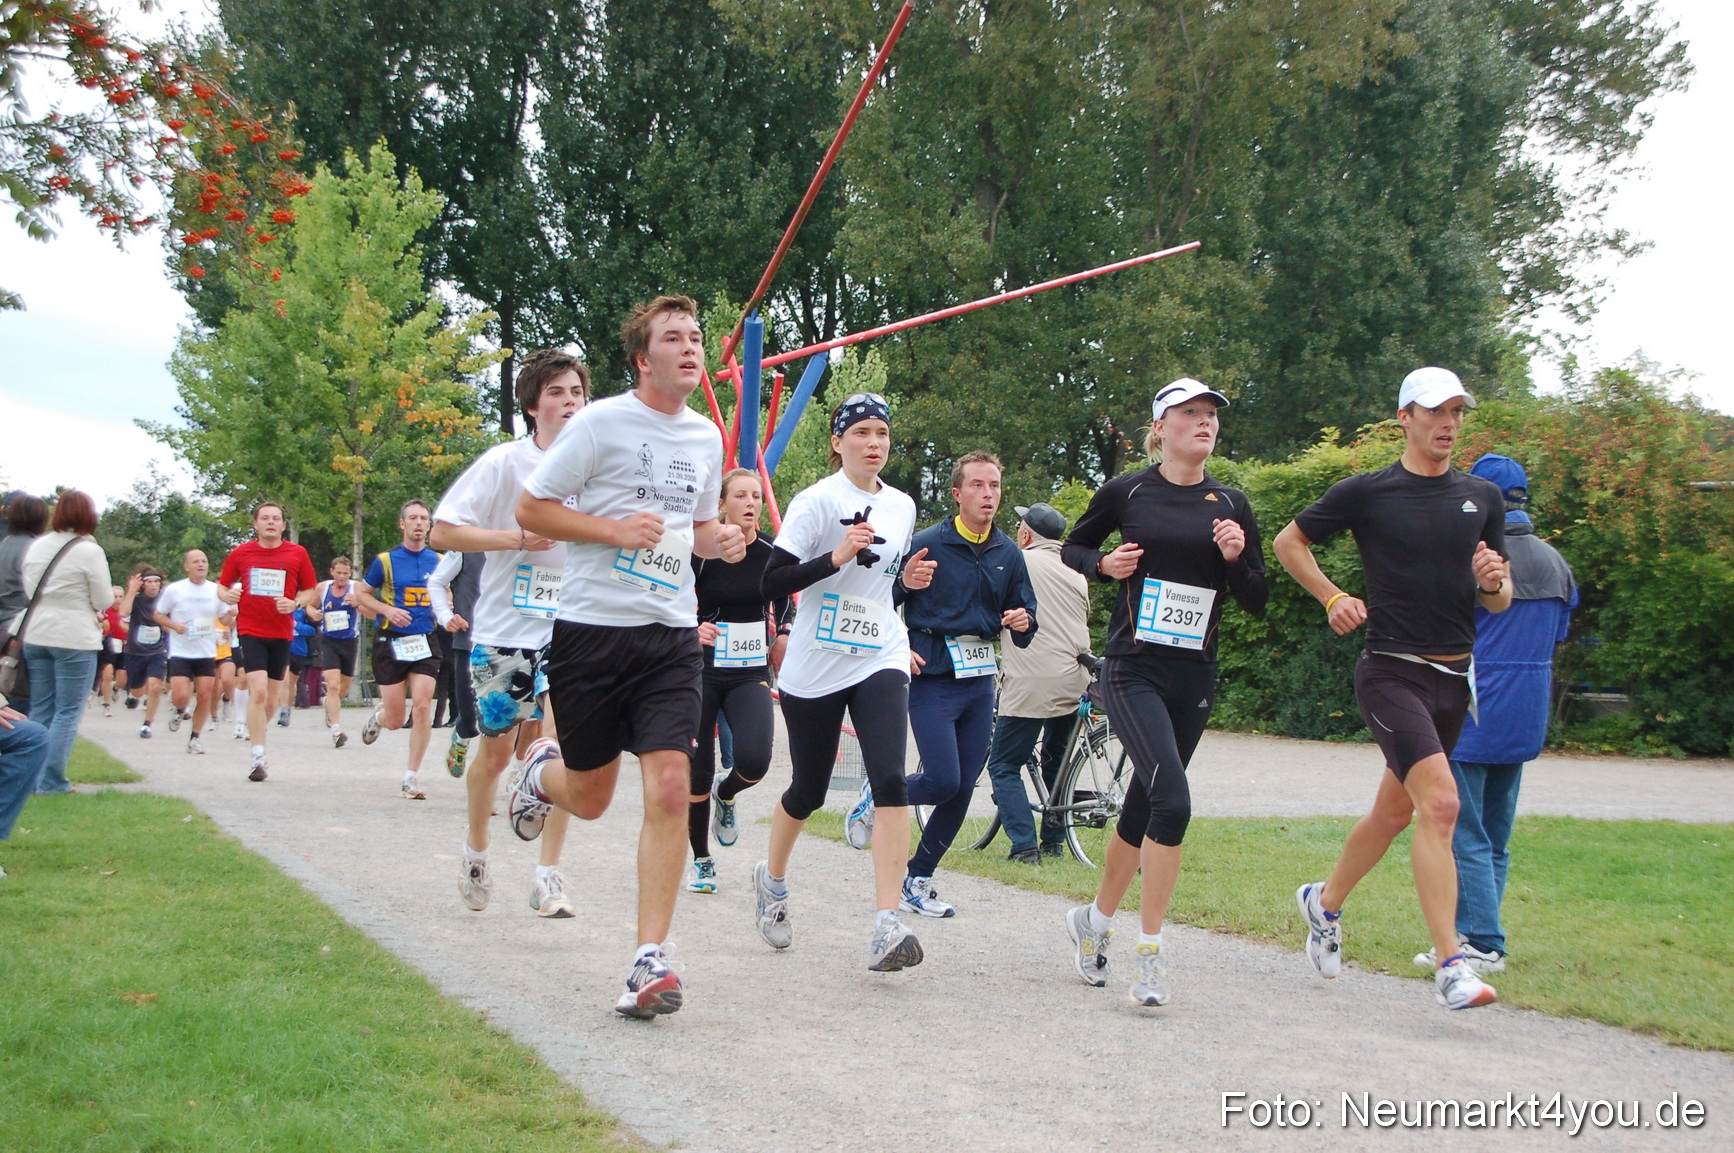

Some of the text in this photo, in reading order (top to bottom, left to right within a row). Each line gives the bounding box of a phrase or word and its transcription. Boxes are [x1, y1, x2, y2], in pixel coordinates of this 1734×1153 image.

[636, 487, 650, 500] 9.
[642, 548, 681, 576] 3460
[260, 578, 281, 588] 3071
[535, 571, 562, 583] Fabian
[1165, 587, 1201, 605] Vanessa
[842, 600, 866, 614] Britta
[1161, 606, 1204, 628] 2397
[839, 618, 880, 638] 2756
[403, 643, 426, 655] 3312
[732, 638, 762, 652] 3468
[965, 646, 990, 661] 3467
